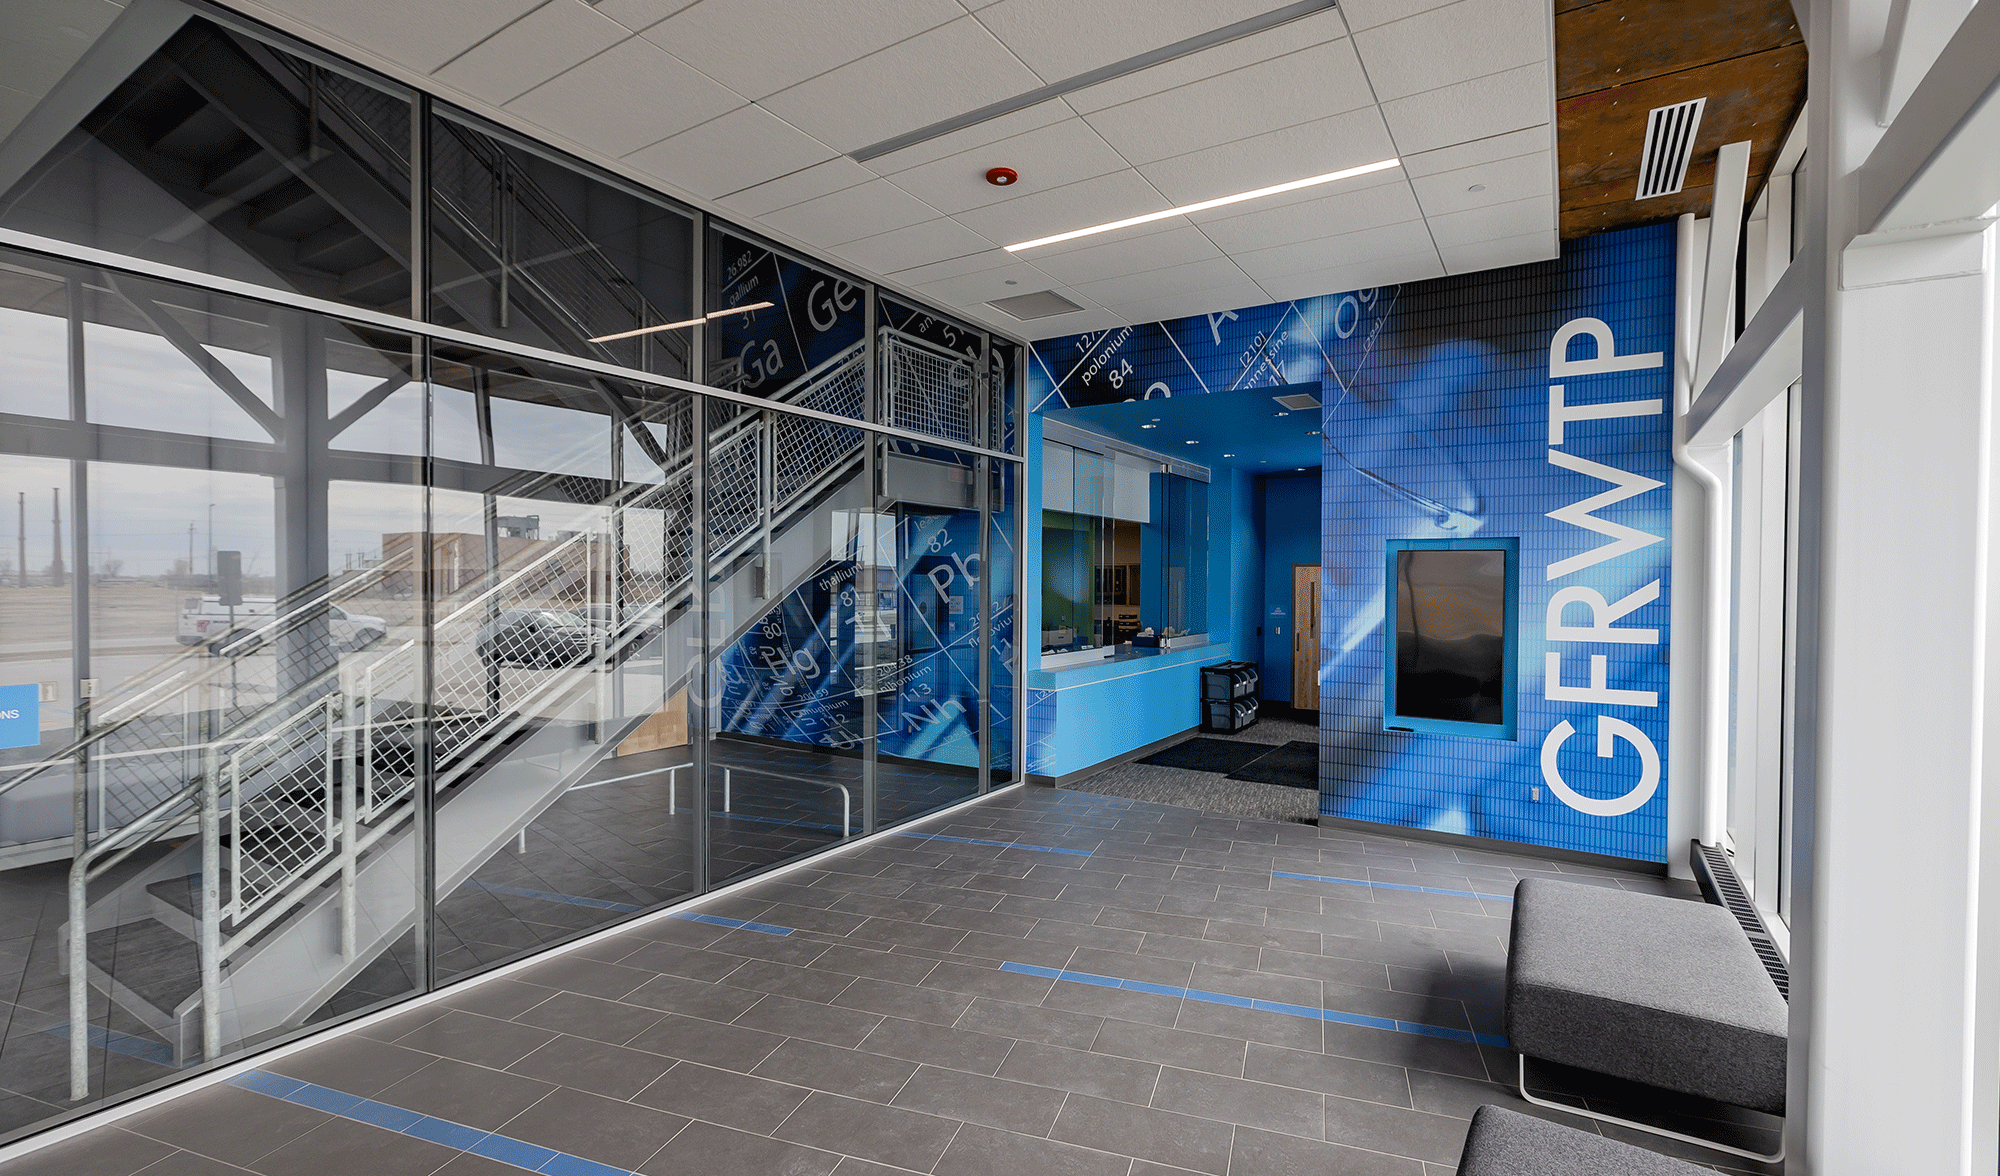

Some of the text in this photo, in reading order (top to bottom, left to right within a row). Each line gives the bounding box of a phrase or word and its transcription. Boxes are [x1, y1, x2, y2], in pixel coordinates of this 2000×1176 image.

[729, 275, 759, 308] gallium
[807, 279, 858, 332] Ge
[1081, 325, 1134, 387] polonium
[1108, 358, 1134, 390] 84
[927, 528, 953, 554] 82
[818, 562, 864, 593] thallium
[927, 551, 980, 605] Pb
[1541, 317, 1667, 817] GFRWTP
[840, 586, 861, 608] 81
[762, 622, 782, 640] 80
[761, 647, 821, 680] Hg
[900, 682, 933, 703] 113
[901, 698, 968, 732] Nh
